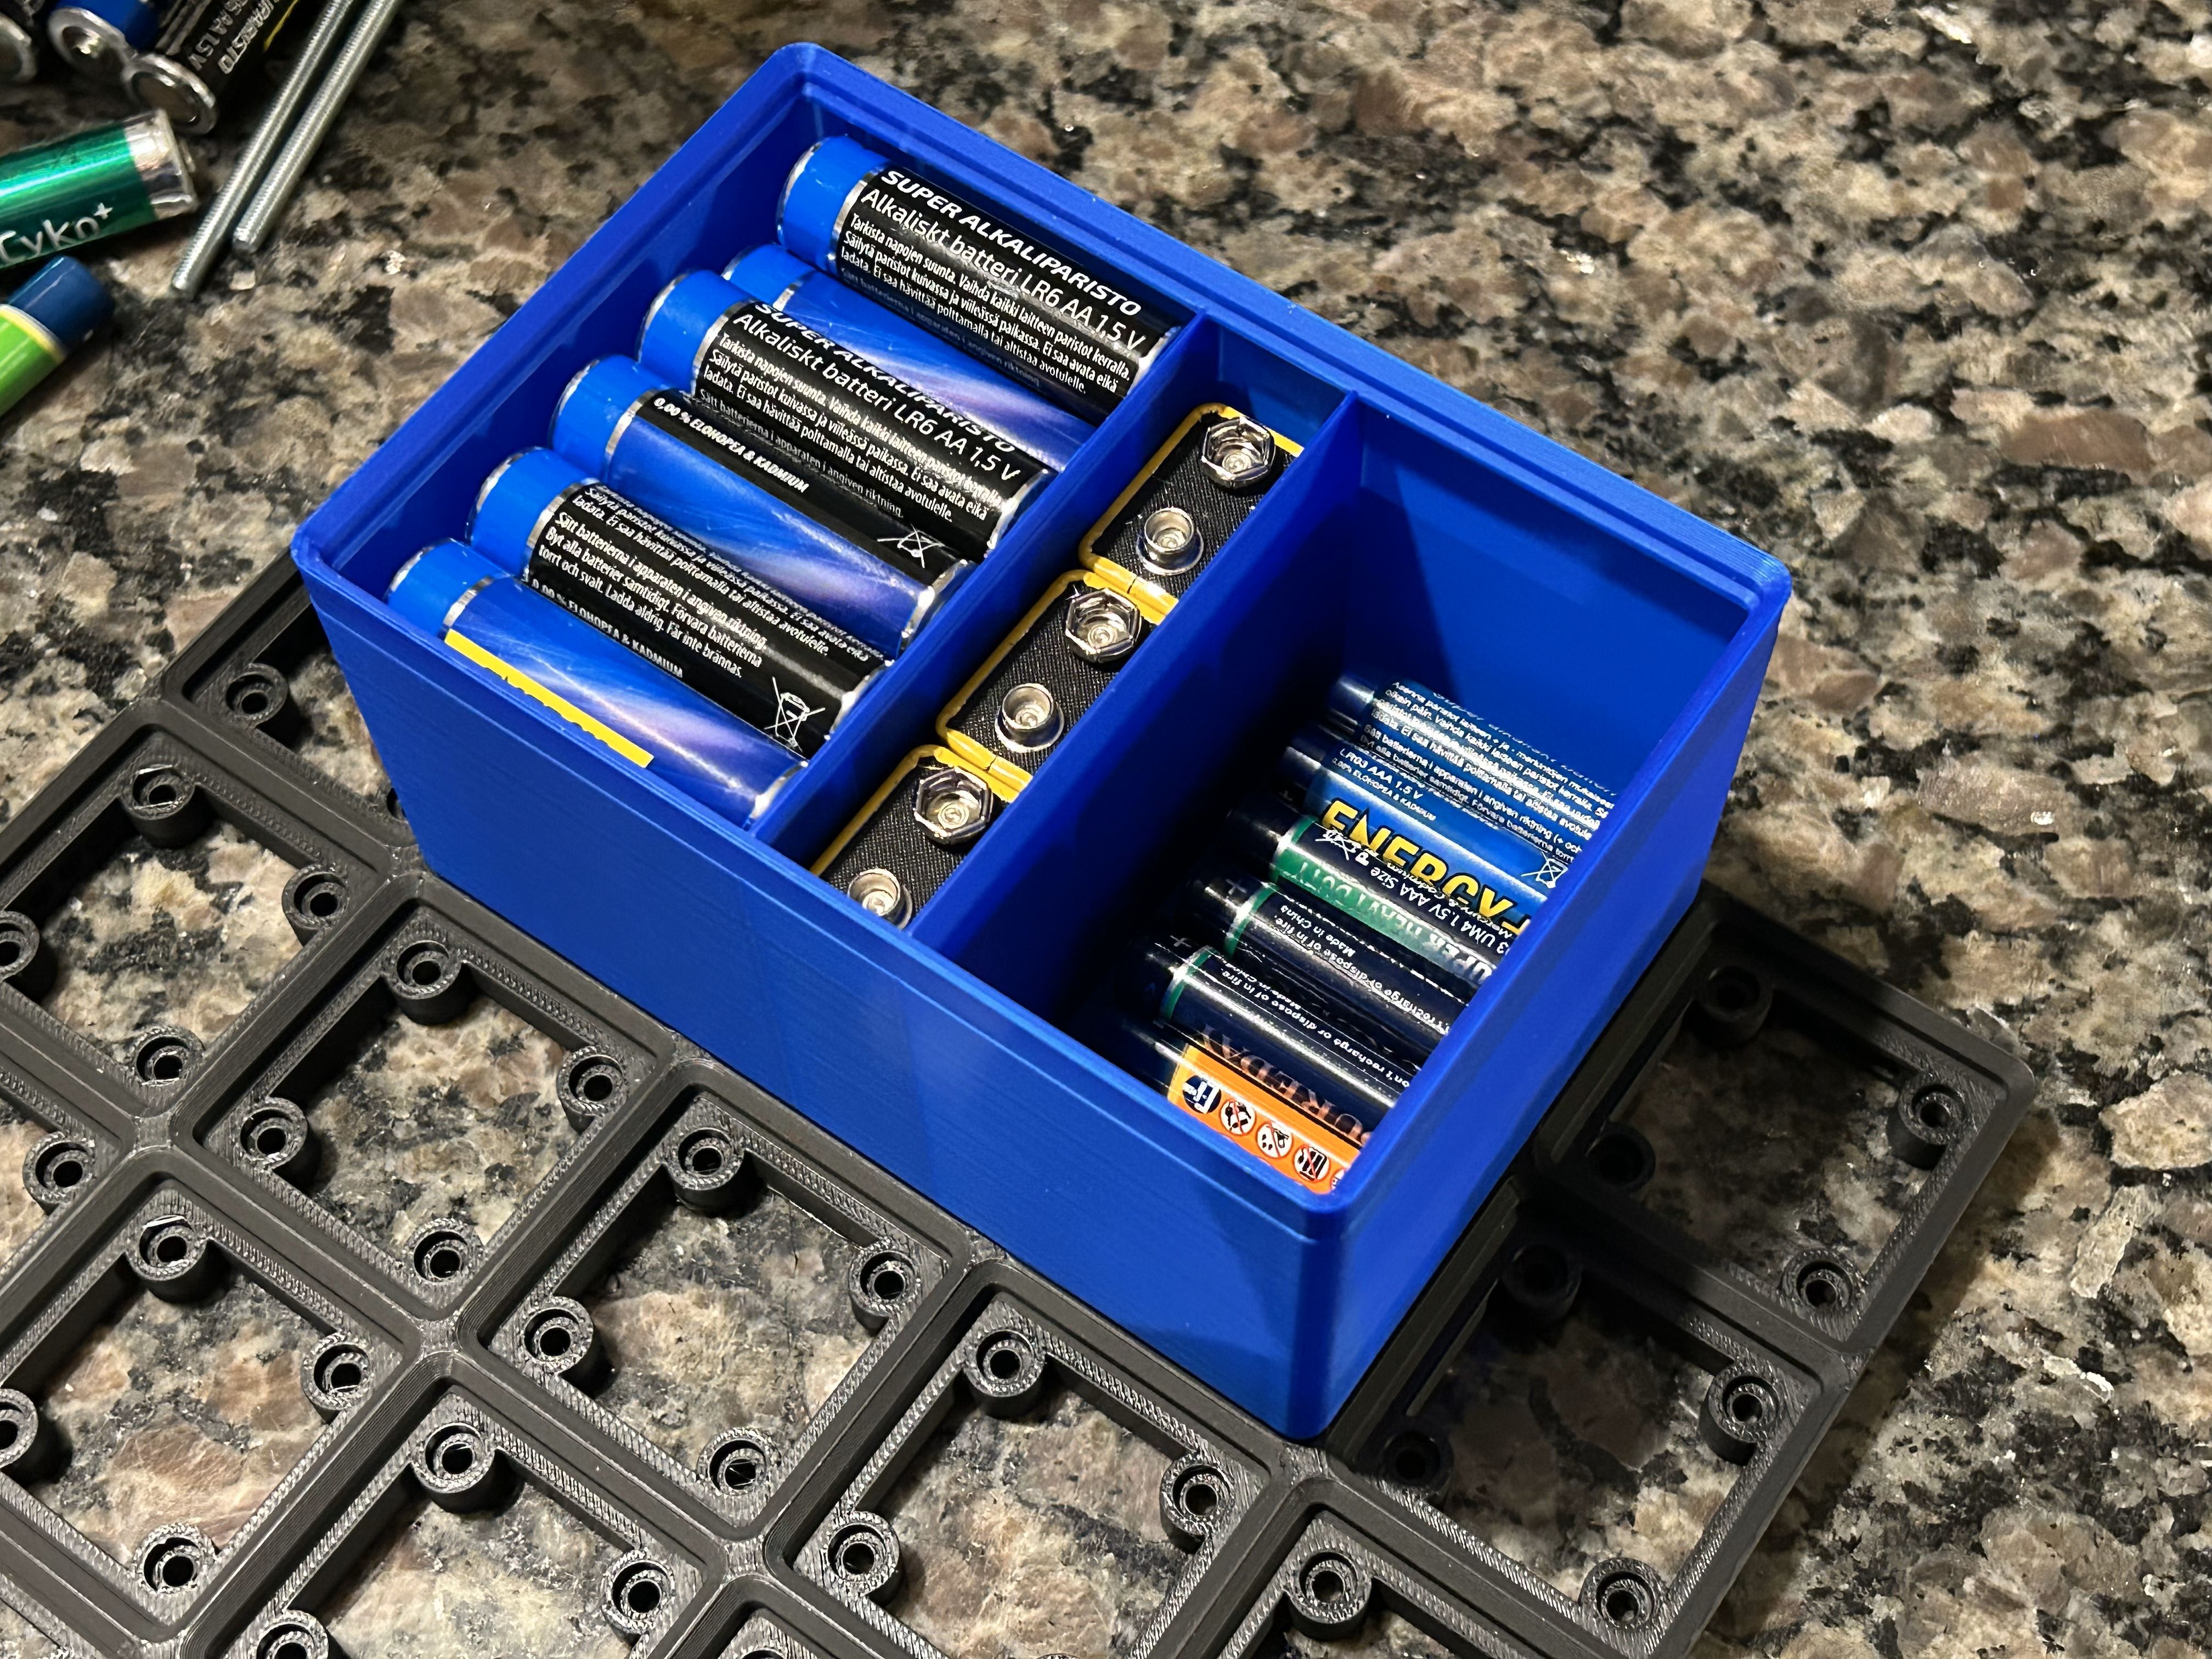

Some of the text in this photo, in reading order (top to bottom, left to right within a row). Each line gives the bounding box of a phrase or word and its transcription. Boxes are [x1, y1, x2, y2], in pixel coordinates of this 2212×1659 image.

[218, 0, 278, 74] IPARISTO
[850, 213, 1129, 380] Tarkista napojen suunta. Vaihda kaikki laitteen paristot kerralla.
[861, 189, 1146, 354] Alkaliskt batteri LR6 AA 1,5 V
[881, 171, 1141, 315] SUPER ALKALIPARISTO
[755, 303, 834, 349] SUPER
[833, 351, 1014, 452] ALKALIPARISTO
[841, 246, 1085, 393] ladata. Ei saa hävittää polttamalla tai altistaa avotulelle.
[843, 230, 875, 258] Säilytä
[874, 251, 911, 278] paristot
[911, 268, 949, 299] kuivassa
[948, 290, 960, 305] ja
[998, 320, 1040, 351] paikassa.
[1042, 340, 1055, 357] Ei
[1051, 349, 1069, 366] saa
[1069, 359, 1095, 381] avata
[1096, 374, 1118, 392] eikä
[653, 397, 809, 492] 0,00 % ELOHOPEA & KADMIUM
[703, 364, 952, 522] ladata. Ei saa hävittää polttamalla tai altistaa avotulelle.
[708, 349, 991, 520] Säilytä paristot kuivassa ja viileässä paikassa. Ei saa avata eikä
[719, 332, 755, 363] Tarkista
[754, 357, 794, 385] napojen
[792, 379, 828, 406] suunta.
[828, 396, 861, 425] Vaihda
[860, 415, 891, 442] kaikki
[888, 432, 927, 466] laitteen
[733, 314, 1020, 480] Alkaliskt batteri LR6 AA 1,5 V
[538, 544, 742, 678] torrt och svalt. Ladda aldrig. Får inte brännas.
[545, 526, 761, 667] Byt alla batterier samtidigt. Förvara batterierna
[553, 511, 578, 533] Sätt
[575, 523, 629, 564] batterierna
[628, 555, 637, 568] i
[633, 561, 684, 597] apparaten
[681, 588, 691, 601] i
[686, 594, 727, 627] angiven
[572, 494, 828, 656] ladata. Ei saa hävittää polttamalla tai altistaa avotulelle.
[1269, 915, 1295, 937] fire.
[1280, 905, 1356, 957] Made in China
[1293, 931, 1308, 945] in
[1306, 939, 1321, 954] of
[1321, 949, 1367, 983] dispose
[1370, 867, 1495, 947] UM4 1.5V AAA Size
[1423, 932, 1492, 979] UPER
[1369, 979, 1383, 992] or
